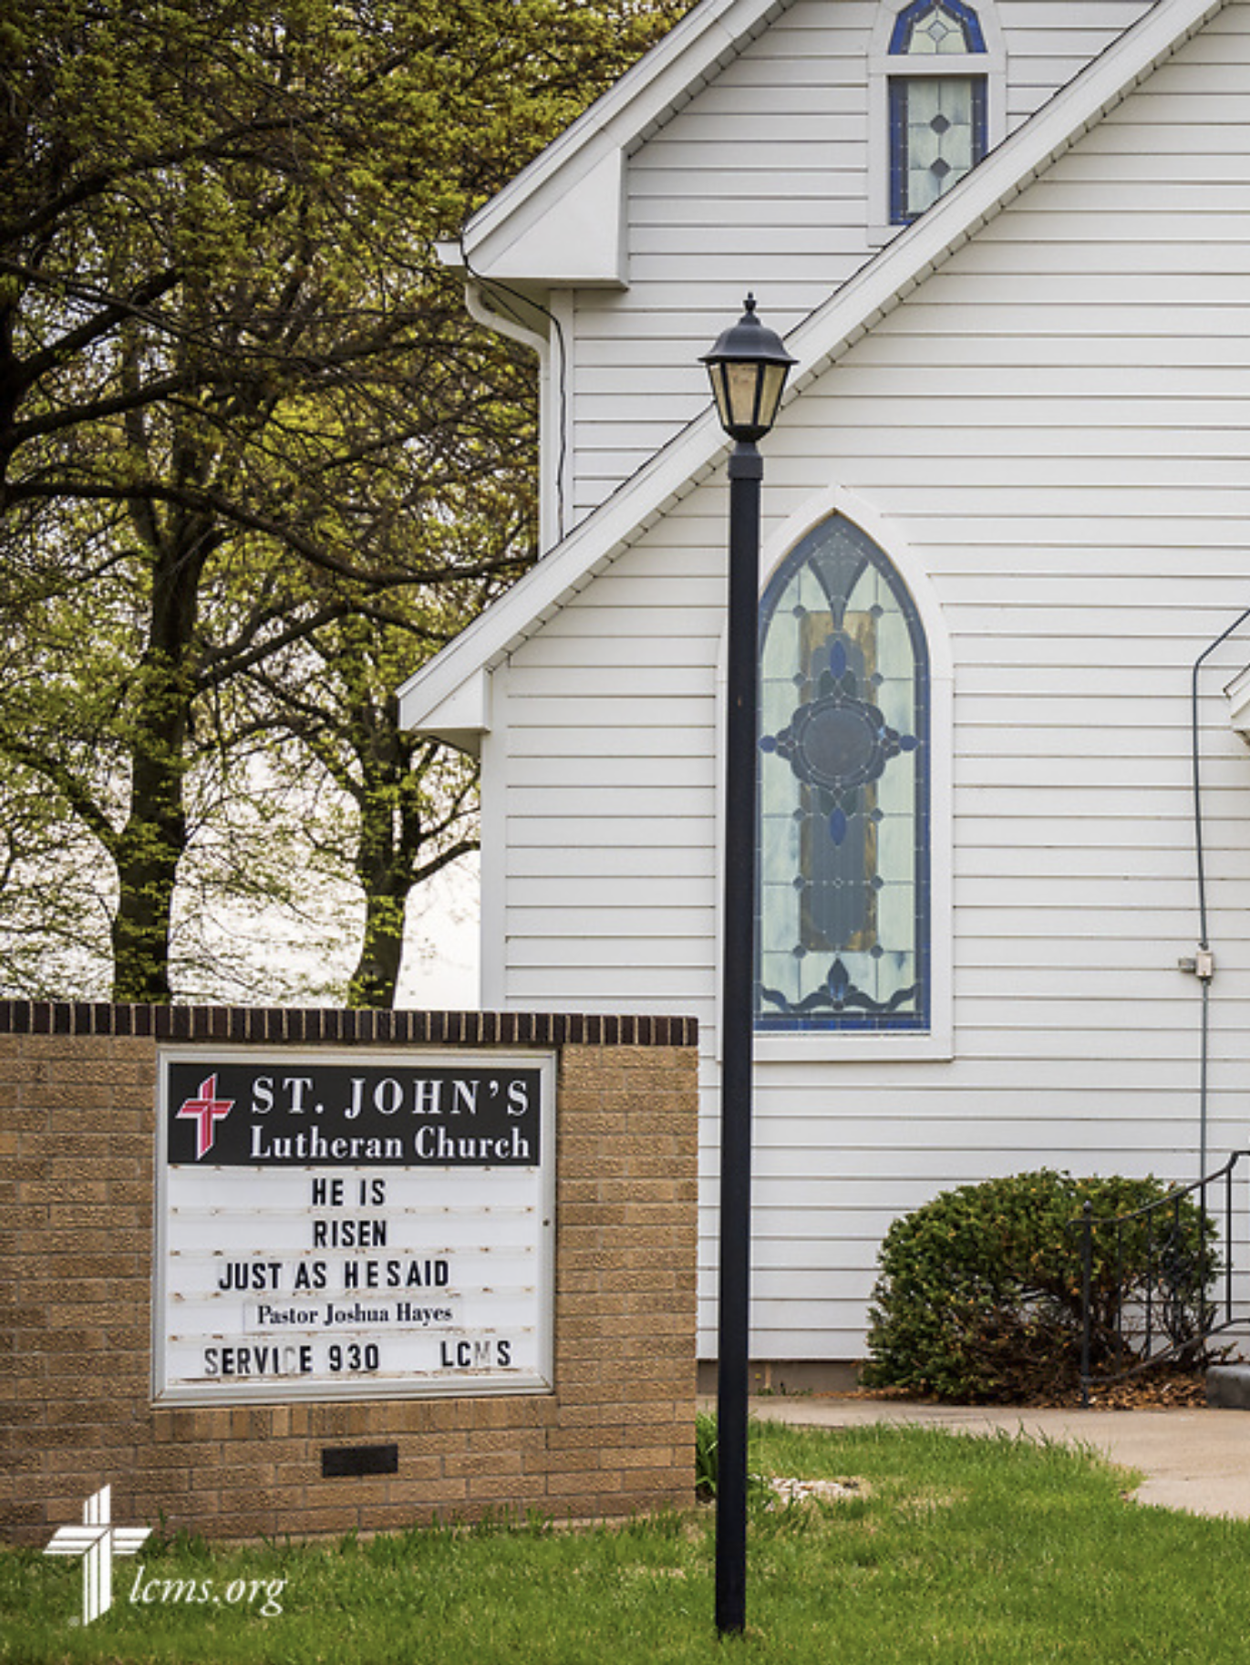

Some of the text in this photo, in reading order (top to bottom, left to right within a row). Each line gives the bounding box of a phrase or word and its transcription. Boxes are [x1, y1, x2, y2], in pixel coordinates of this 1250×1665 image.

[251, 1076, 529, 1119] ST. JOHN'S
[251, 1125, 530, 1159] Lutheran Church
[312, 1178, 386, 1206] HE IS
[312, 1220, 388, 1248] RISEN
[218, 1262, 283, 1290] JUST
[294, 1262, 327, 1289] AS
[257, 1302, 453, 1326] Pastor Joshua Hayes
[204, 1340, 511, 1375] SERVICE 930 LCMS
